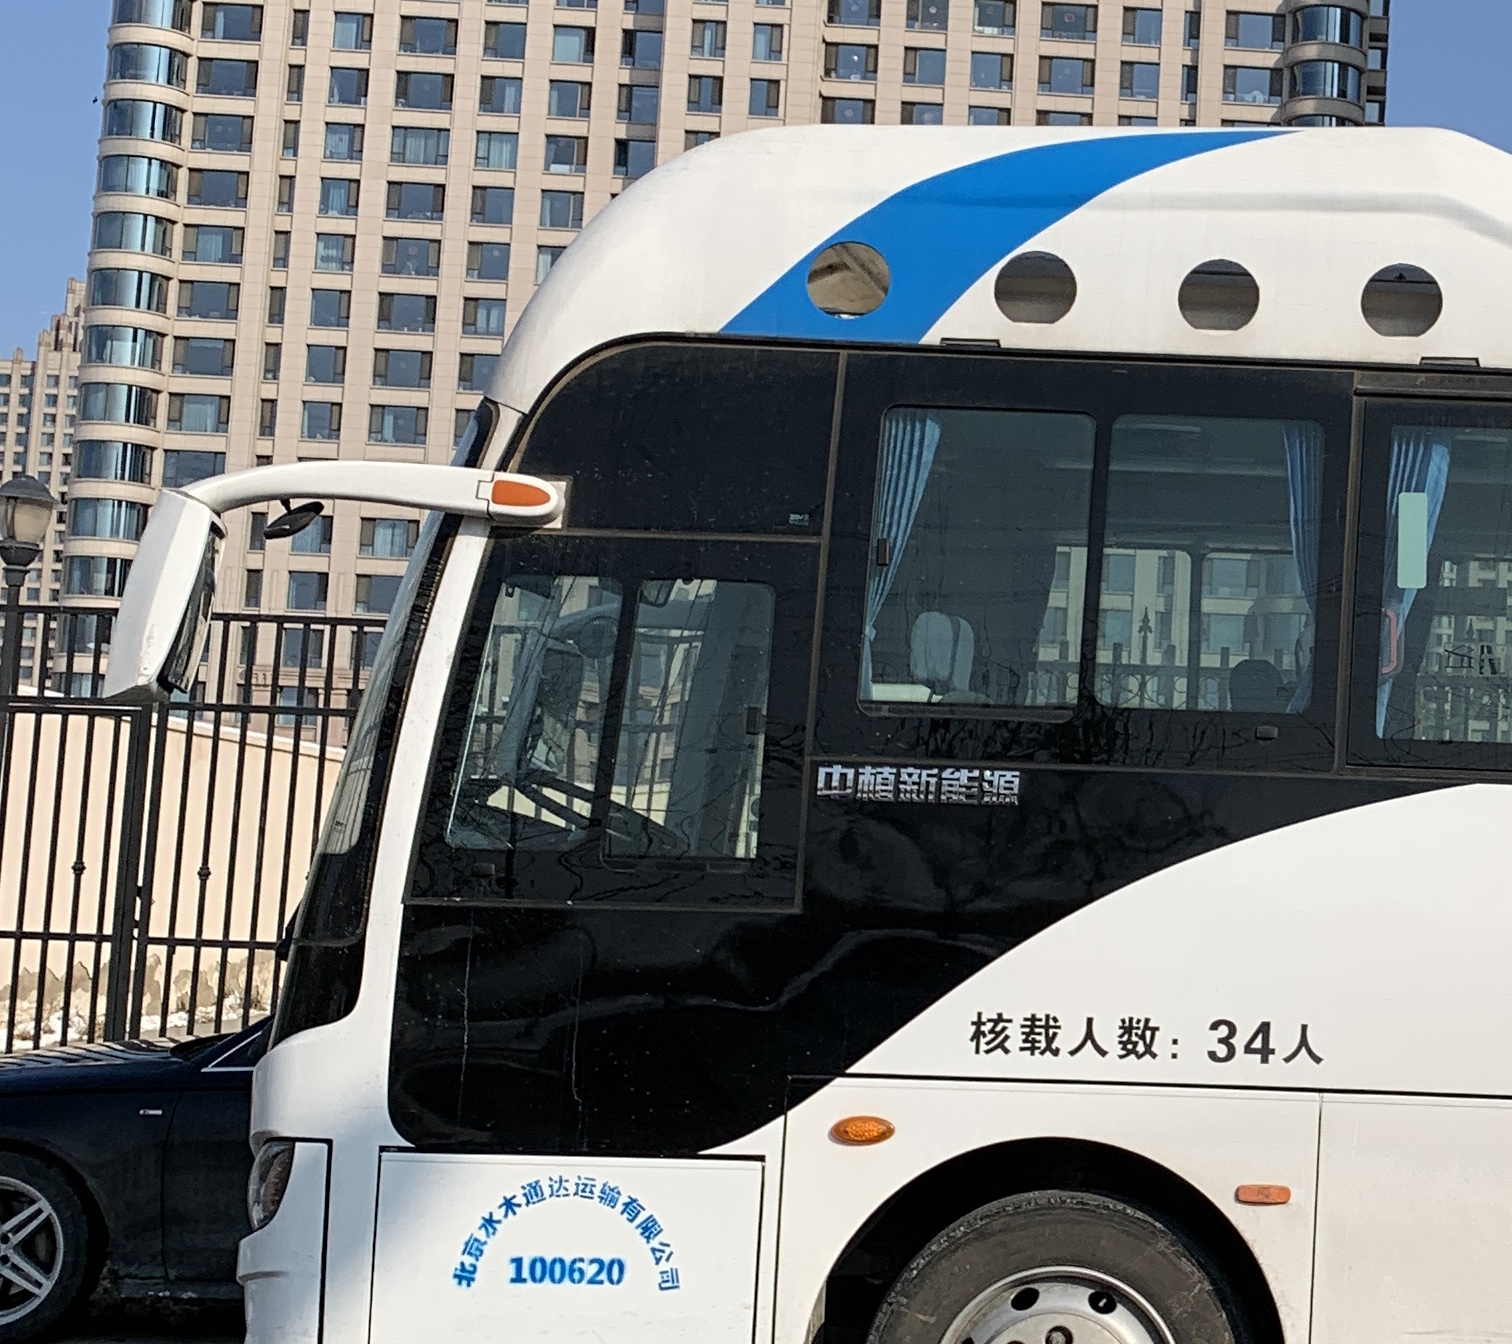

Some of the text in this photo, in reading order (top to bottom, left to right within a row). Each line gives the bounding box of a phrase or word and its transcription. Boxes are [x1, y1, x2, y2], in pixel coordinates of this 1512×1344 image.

[816, 764, 1020, 806] 中植新能源
[452, 1175, 681, 1292] 北京水木通达运输有限公司
[508, 1255, 626, 1286] 100620
